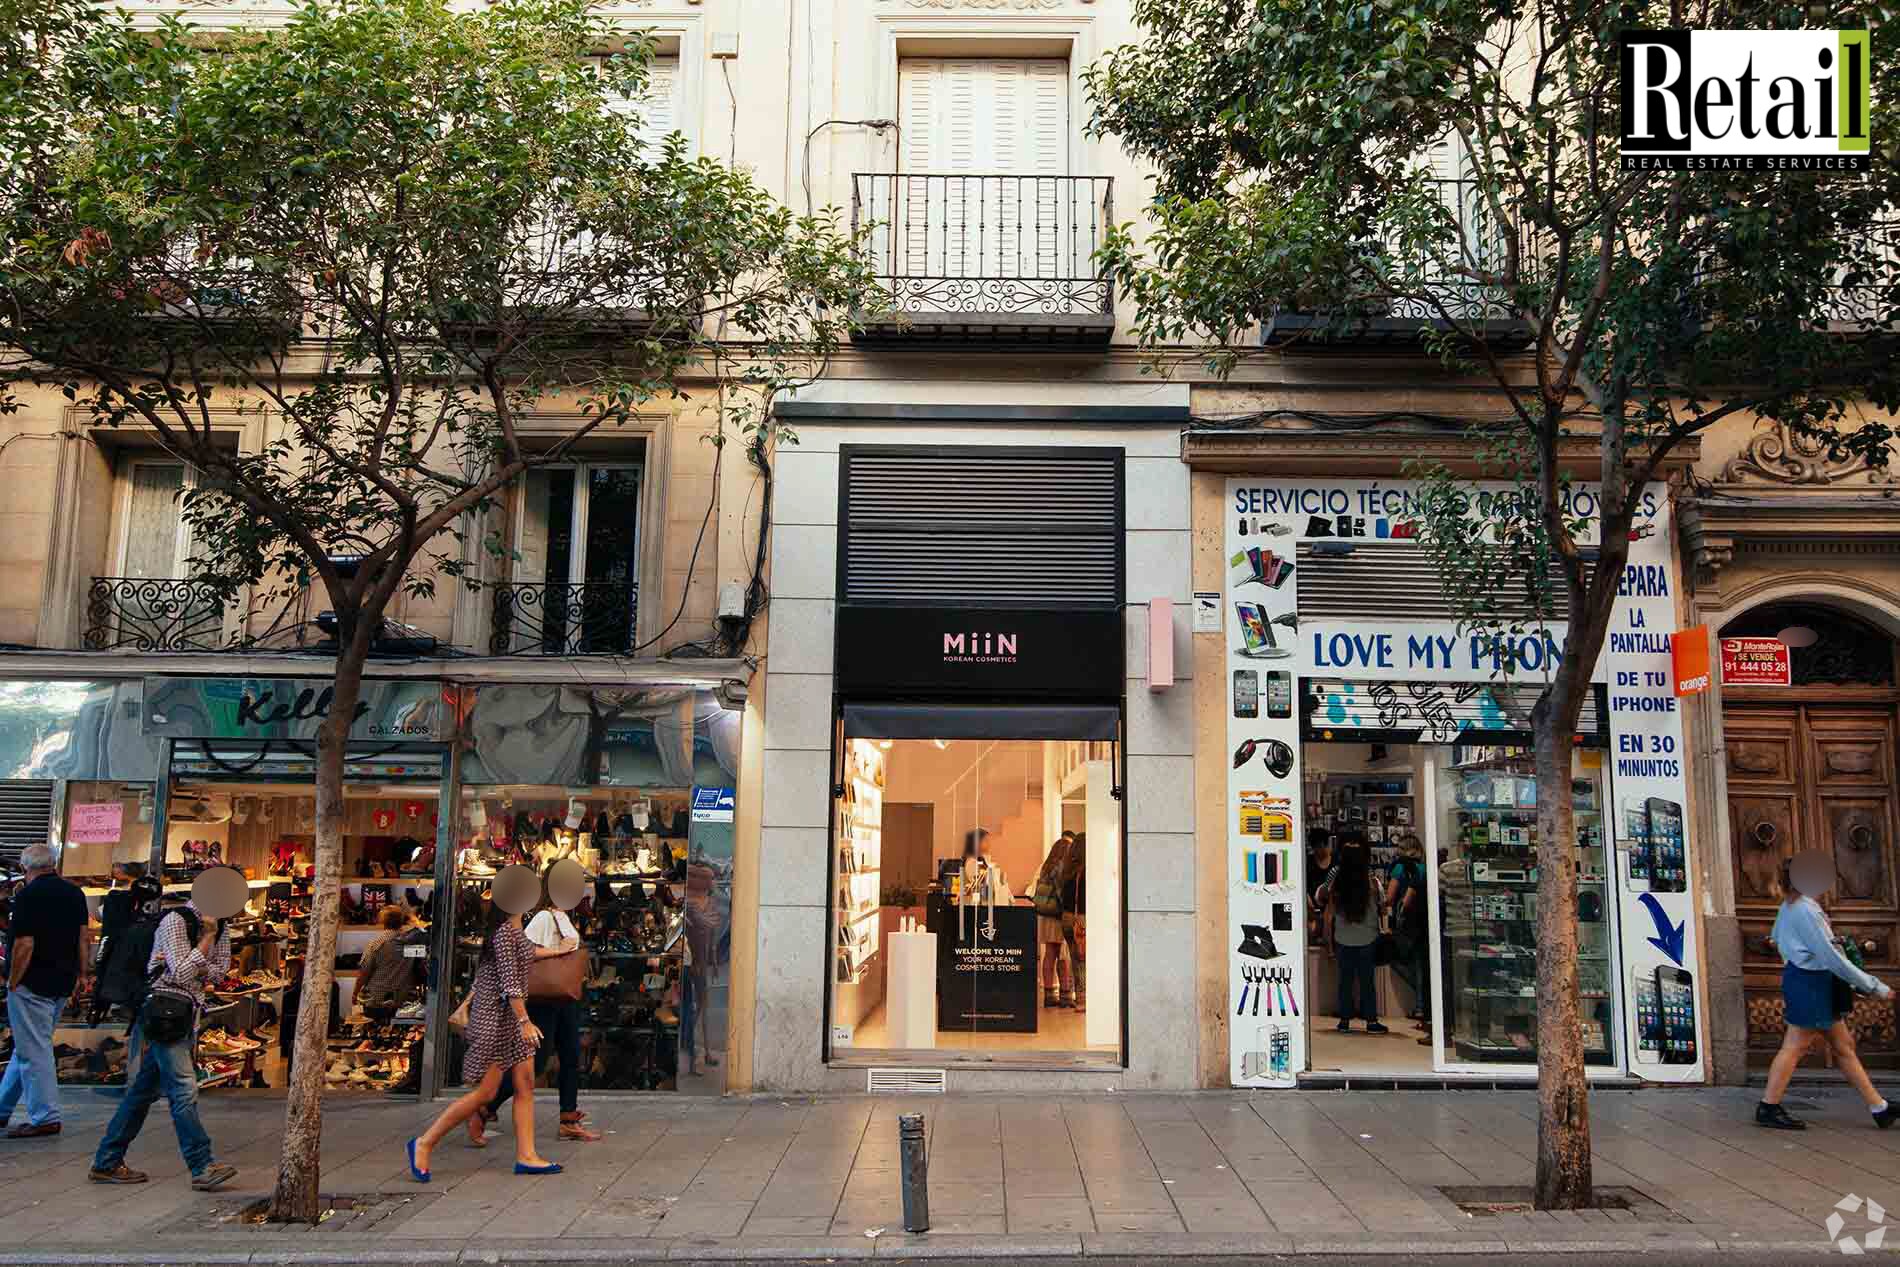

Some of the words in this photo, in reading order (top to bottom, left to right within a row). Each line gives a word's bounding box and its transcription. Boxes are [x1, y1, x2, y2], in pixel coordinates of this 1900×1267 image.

[1235, 488, 1350, 515] SERVICIO
[1357, 482, 1470, 516] TÉCNO
[1616, 565, 1669, 596] EPARA
[1630, 608, 1645, 628] LA
[944, 632, 1017, 655] MiiN
[1314, 632, 1394, 668] LOVE
[1408, 634, 1456, 669] MY
[1471, 636, 1569, 671] PHON
[1610, 633, 1671, 653] PANTALLA
[1725, 662, 1737, 672] 91
[1740, 662, 1760, 672] 444
[1761, 662, 1773, 672] 05
[1775, 662, 1787, 672] 28
[1616, 671, 1638, 687] DE
[1644, 671, 1666, 687] TU
[1680, 675, 1709, 692] orange
[1613, 697, 1676, 712] IPHONE
[369, 725, 430, 735] CALZADOS
[1619, 734, 1643, 753] EN
[1650, 735, 1675, 754] 30
[1618, 759, 1679, 778] MINUNTOS
[956, 964, 995, 972] COSMETICS
[998, 964, 1021, 972] STORE
